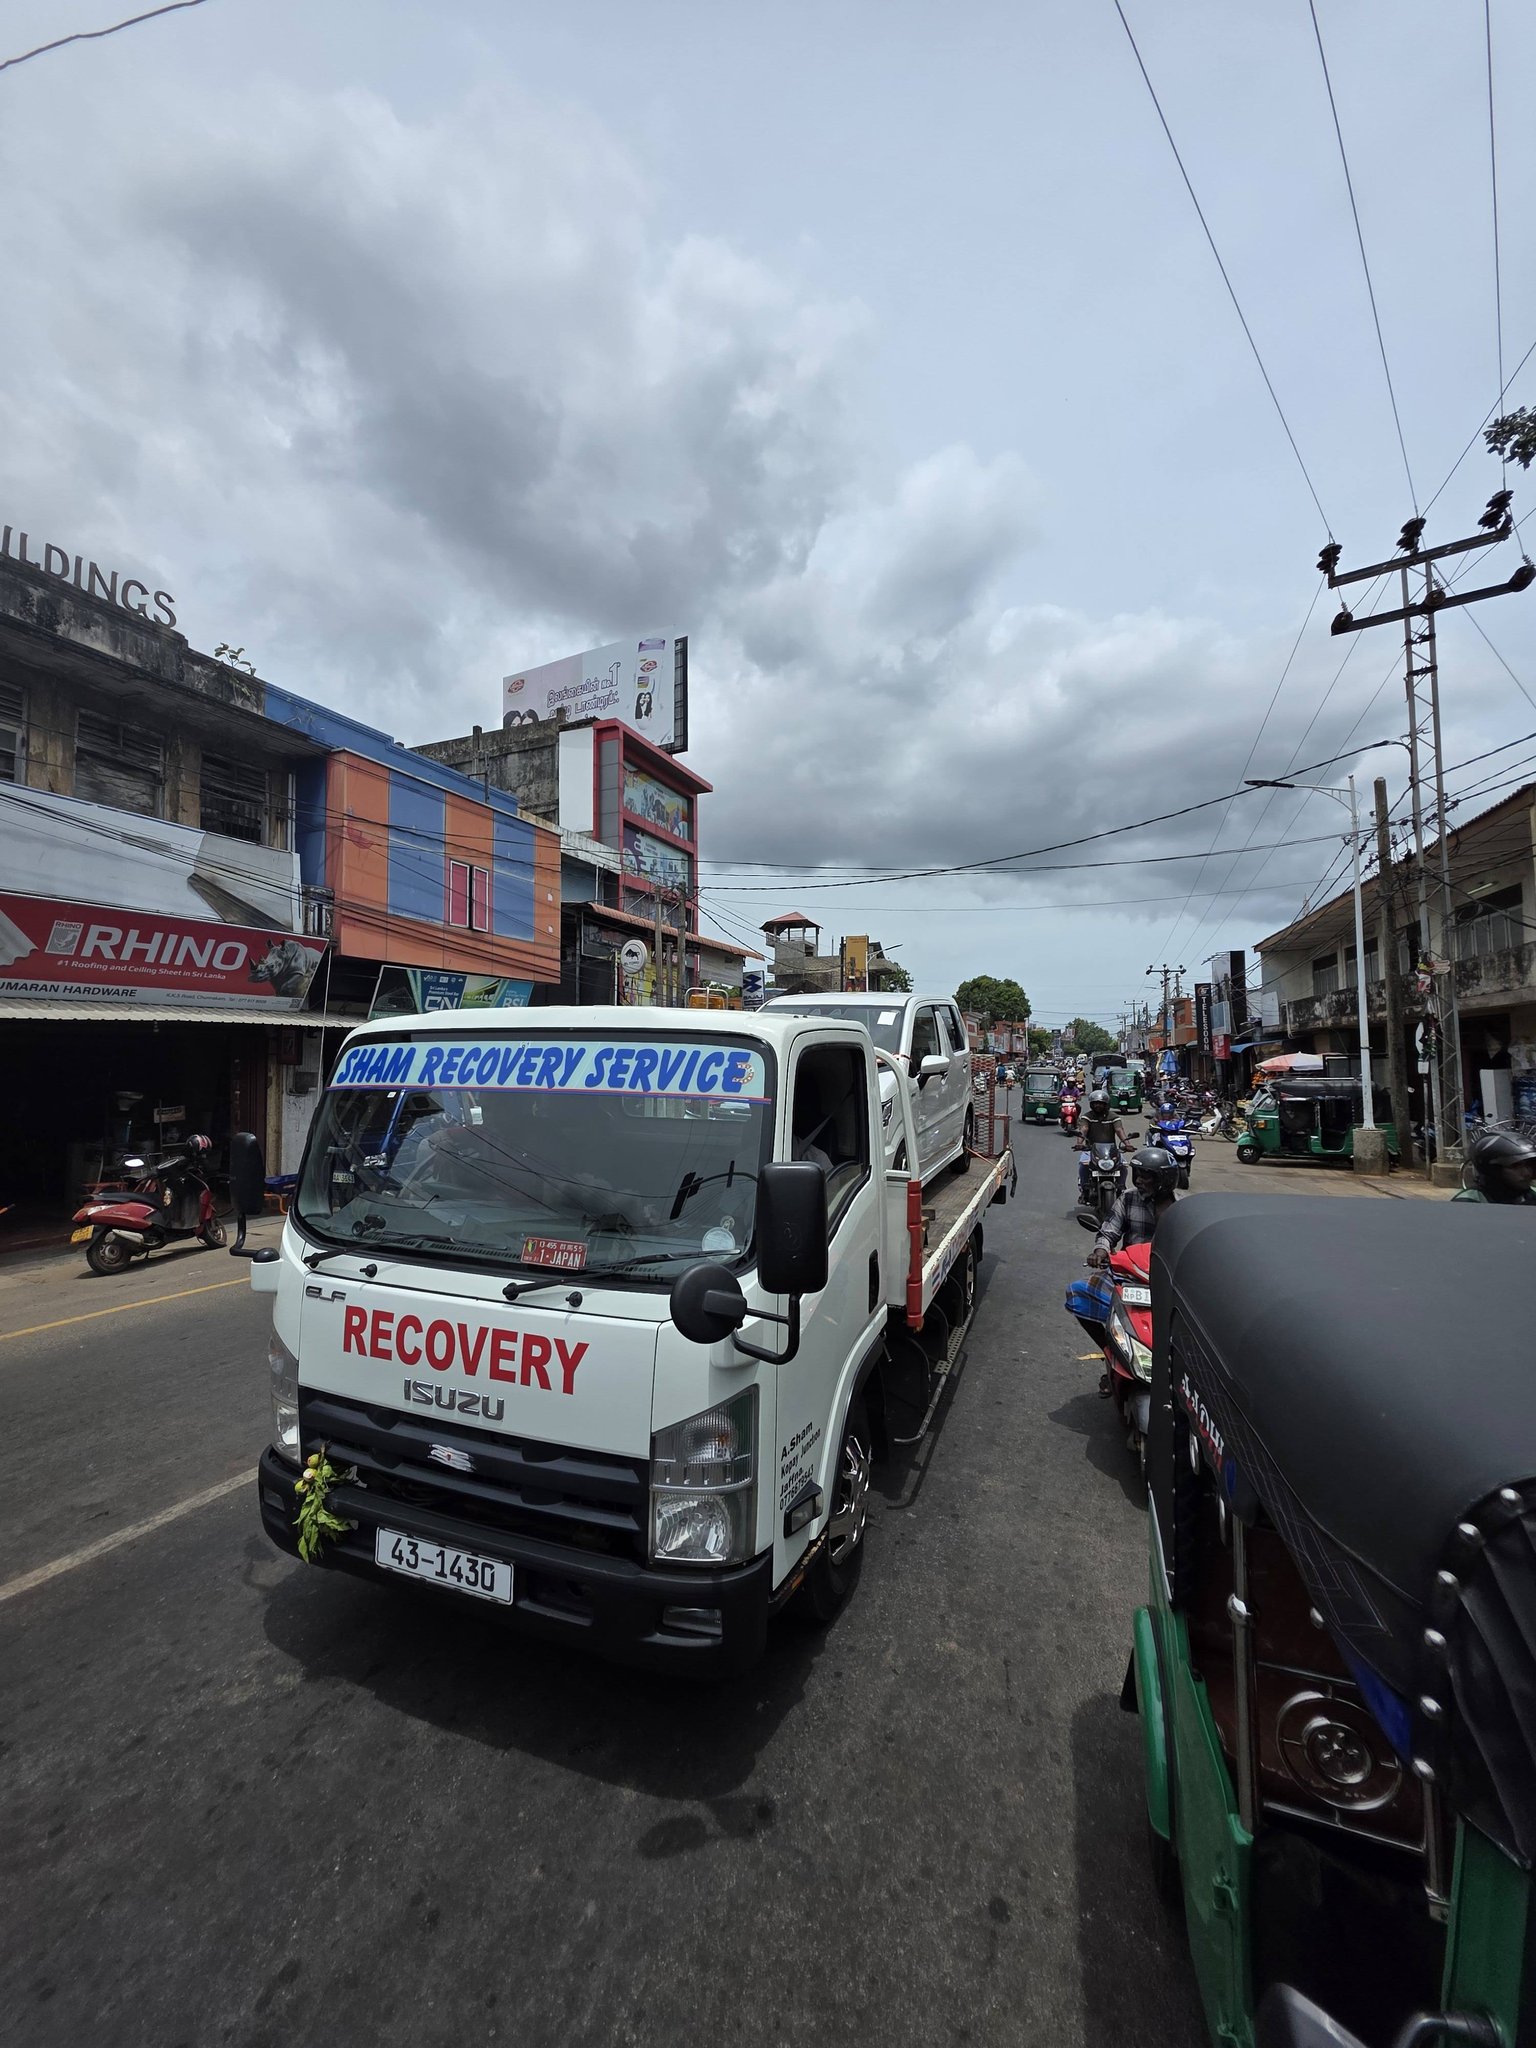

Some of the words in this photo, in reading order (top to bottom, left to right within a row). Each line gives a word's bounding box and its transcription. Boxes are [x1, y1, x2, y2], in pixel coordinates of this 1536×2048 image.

[55, 921, 82, 930] RHINO
[81, 924, 248, 971] RHINO
[57, 959, 69, 967] #1
[71, 961, 108, 972] Roofing
[109, 964, 126, 972] and
[128, 965, 157, 975] Ceiling
[158, 968, 182, 977] Sheet
[182, 969, 191, 977] in
[203, 971, 226, 980] Lanka
[62, 984, 138, 997] HARDWARE
[336, 1047, 417, 1084] SHAM
[417, 1047, 587, 1089] RECOVERY
[584, 1047, 752, 1093] SERVICE
[305, 1285, 347, 1303] ELF
[343, 1305, 590, 1396] RECOVERY
[403, 1377, 505, 1421] ISUZU
[781, 1421, 813, 1462] A.Sham
[781, 1455, 799, 1480] Kopay
[800, 1428, 821, 1459] Junction
[391, 1537, 496, 1592] 43-1430
